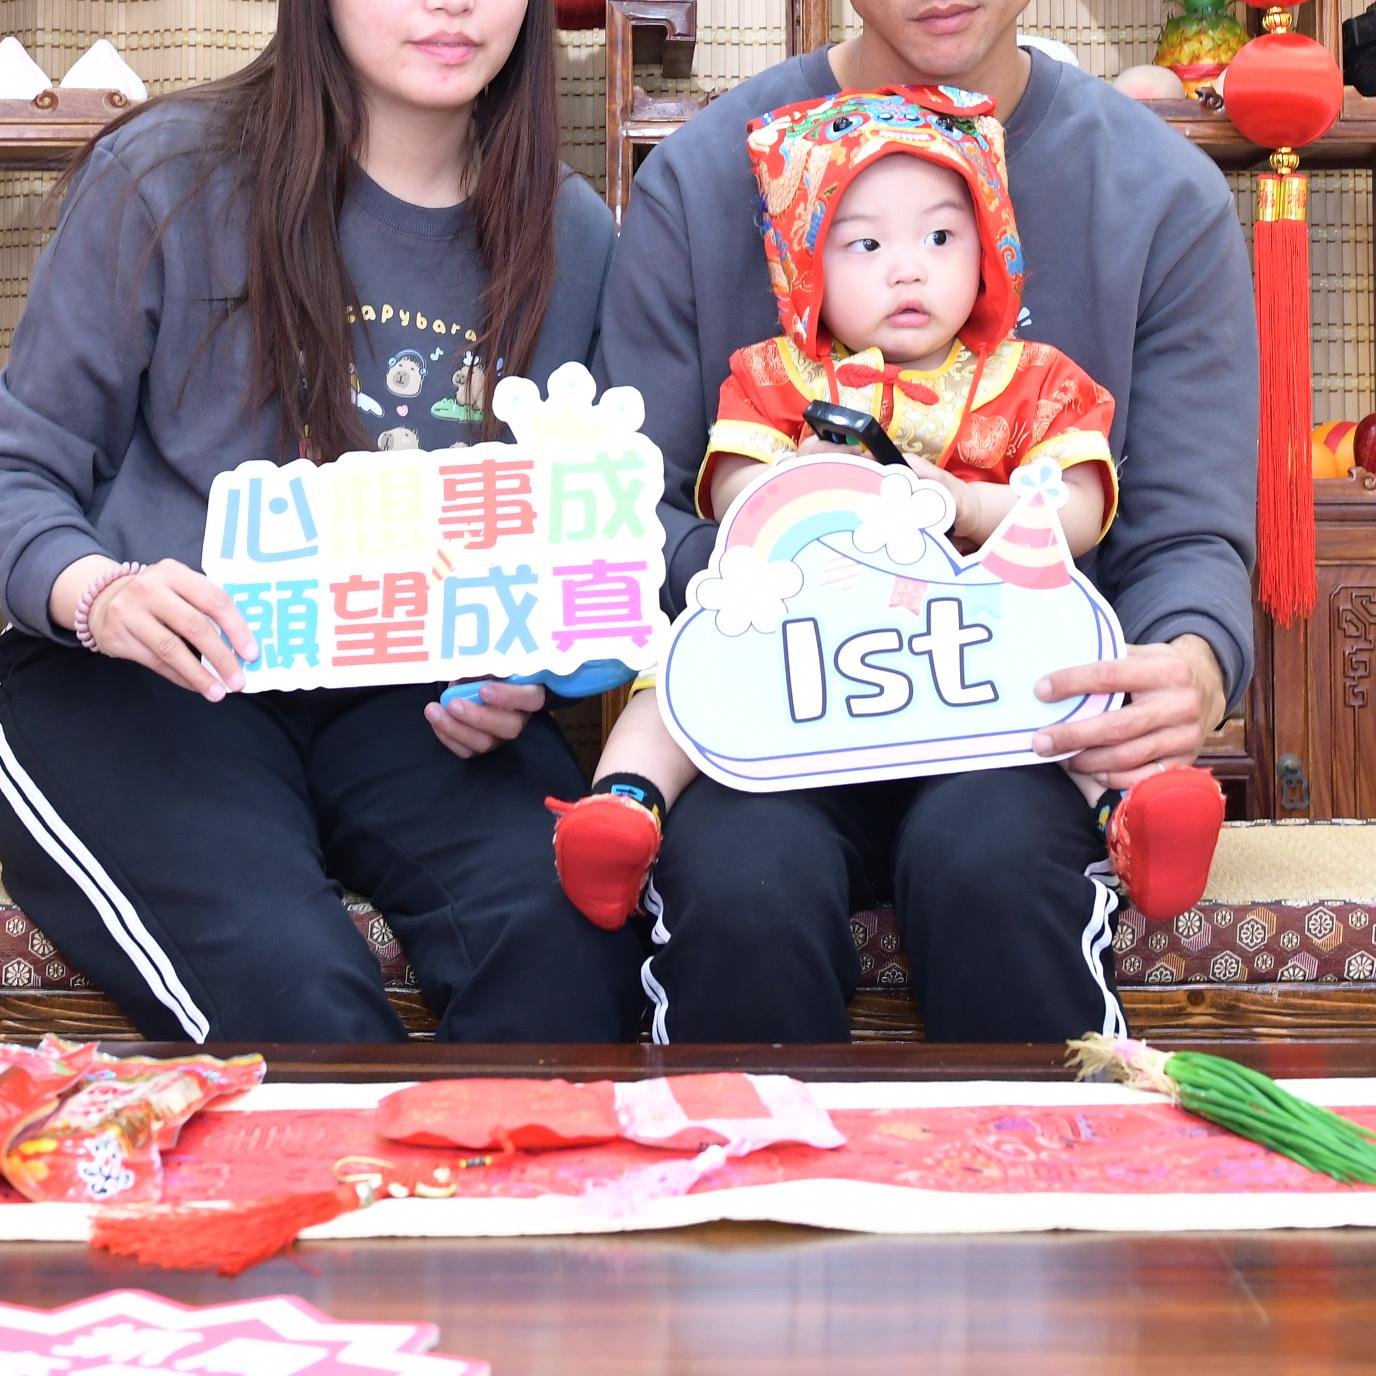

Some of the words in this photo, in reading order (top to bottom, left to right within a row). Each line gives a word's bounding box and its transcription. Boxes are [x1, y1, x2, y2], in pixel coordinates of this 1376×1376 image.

[219, 448, 647, 564] 心想事成
[221, 558, 653, 673] 願望成真
